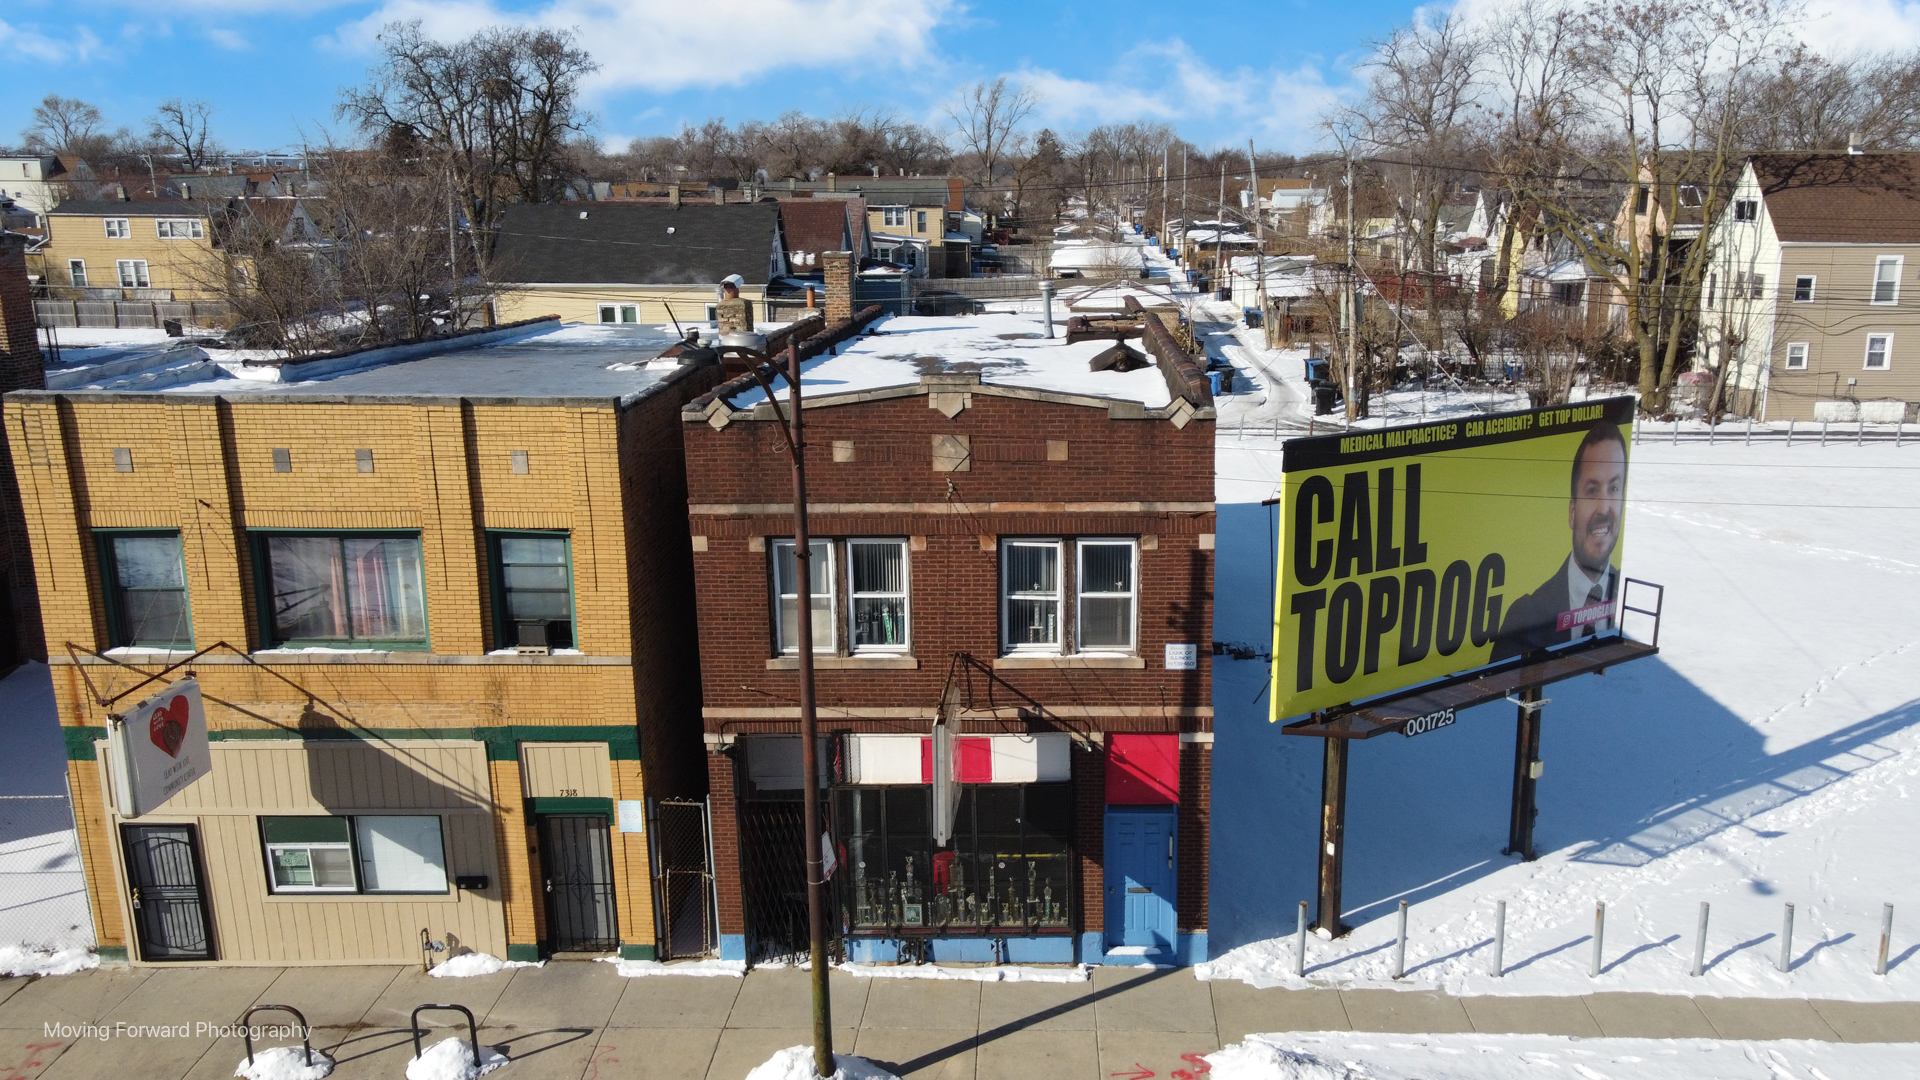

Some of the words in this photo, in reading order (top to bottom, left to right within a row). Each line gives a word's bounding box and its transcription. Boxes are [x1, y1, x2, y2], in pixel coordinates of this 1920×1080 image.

[1340, 433, 1384, 454] MEDICAL
[1386, 424, 1458, 449] MALPRACTICE?
[1466, 421, 1486, 438] CAR
[1486, 414, 1533, 435] ACCIDENT?
[1538, 413, 1553, 428] GET
[1554, 411, 1571, 426] TOP
[1571, 405, 1604, 423] DOLLAR!
[1294, 463, 1428, 587] CALL
[1291, 552, 1506, 692] TOPDOG
[154, 721, 164, 731] LOVE
[1406, 708, 1455, 736] 001725
[163, 768, 172, 779] LEAD
[173, 761, 182, 773] WITH
[560, 789, 578, 797] 7318
